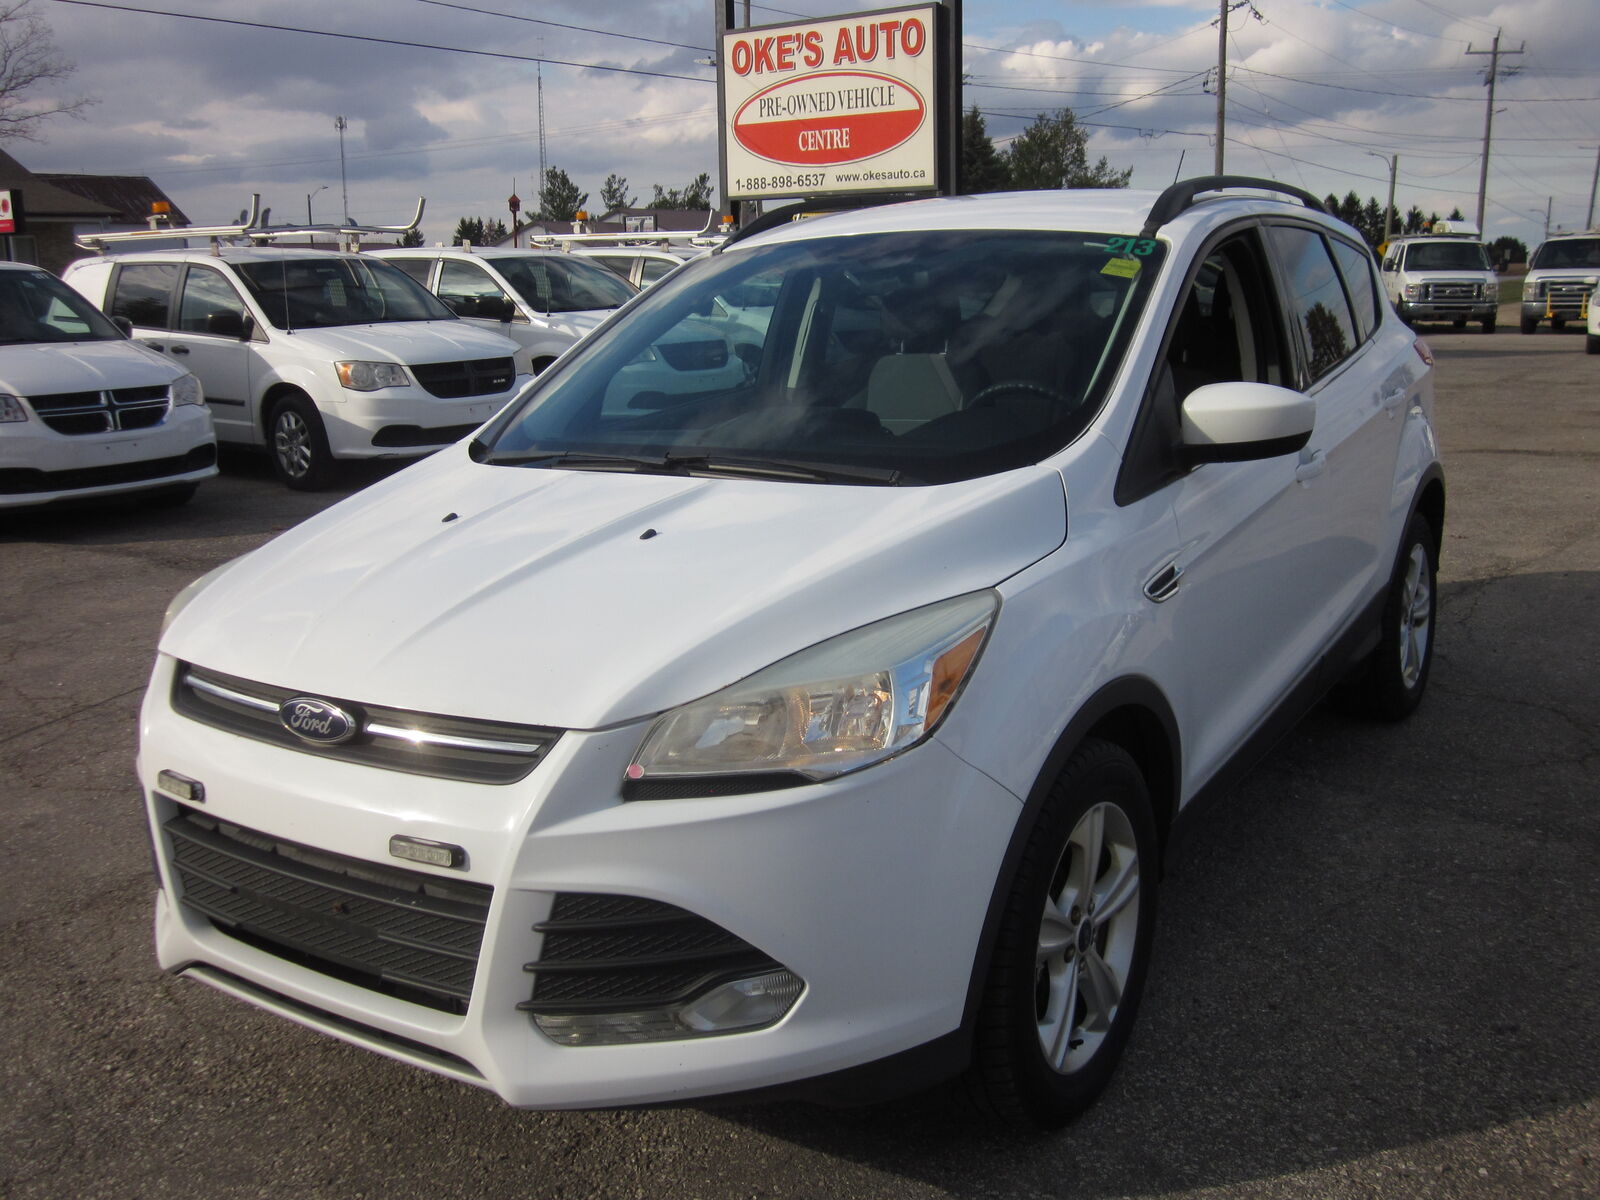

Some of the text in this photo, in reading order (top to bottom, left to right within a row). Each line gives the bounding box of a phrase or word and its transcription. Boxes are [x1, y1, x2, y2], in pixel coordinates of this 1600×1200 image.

[732, 18, 926, 77] OKE'S AUTO
[759, 85, 896, 118] PRE-OWNED VEHICLE
[798, 128, 850, 151] CENTRE
[735, 169, 926, 191] 1-888-898-6537 www.okesauto.ca
[1104, 237, 1157, 255] 213
[291, 703, 333, 734] Ford
